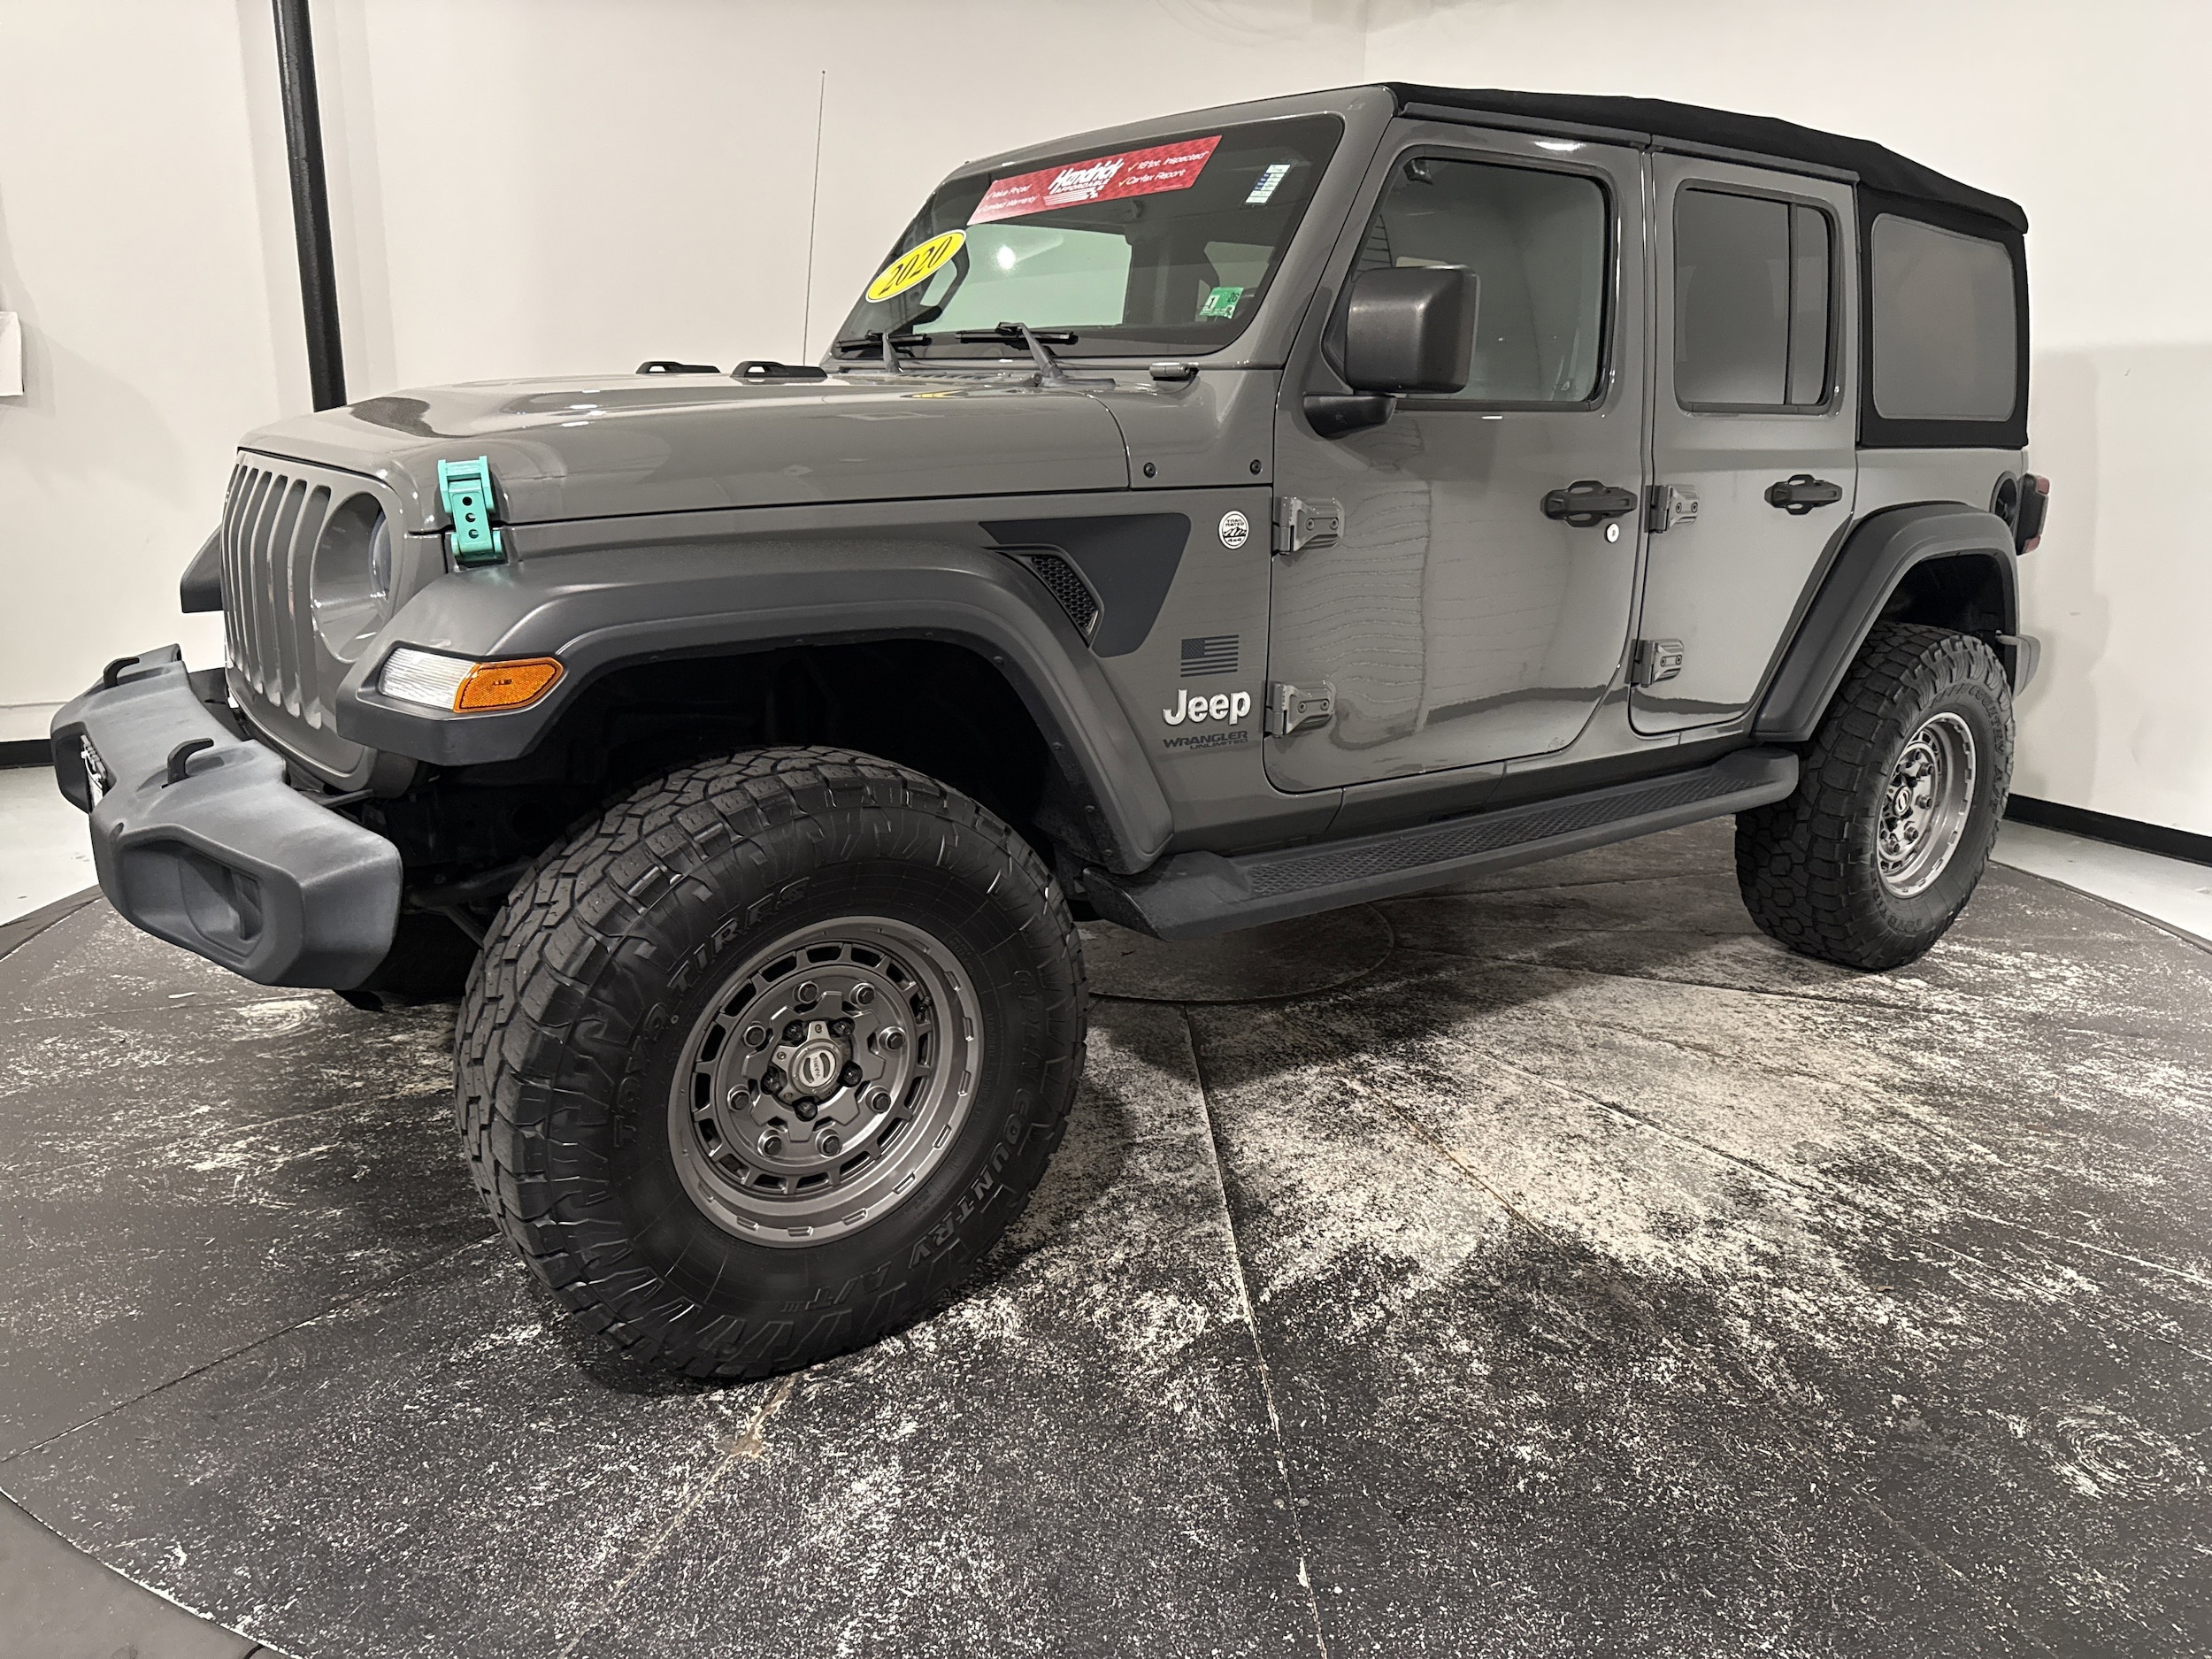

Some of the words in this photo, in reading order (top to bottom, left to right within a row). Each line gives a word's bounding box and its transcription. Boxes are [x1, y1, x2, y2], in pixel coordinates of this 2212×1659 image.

[1047, 157, 1125, 196] Hendrick
[877, 235, 953, 296] 2020
[1162, 688, 1252, 726] Jeep
[1162, 730, 1248, 749] WRANGLER
[1188, 738, 1248, 750] UNLIMITED
[908, 1088, 1032, 1270] COUNTRY
